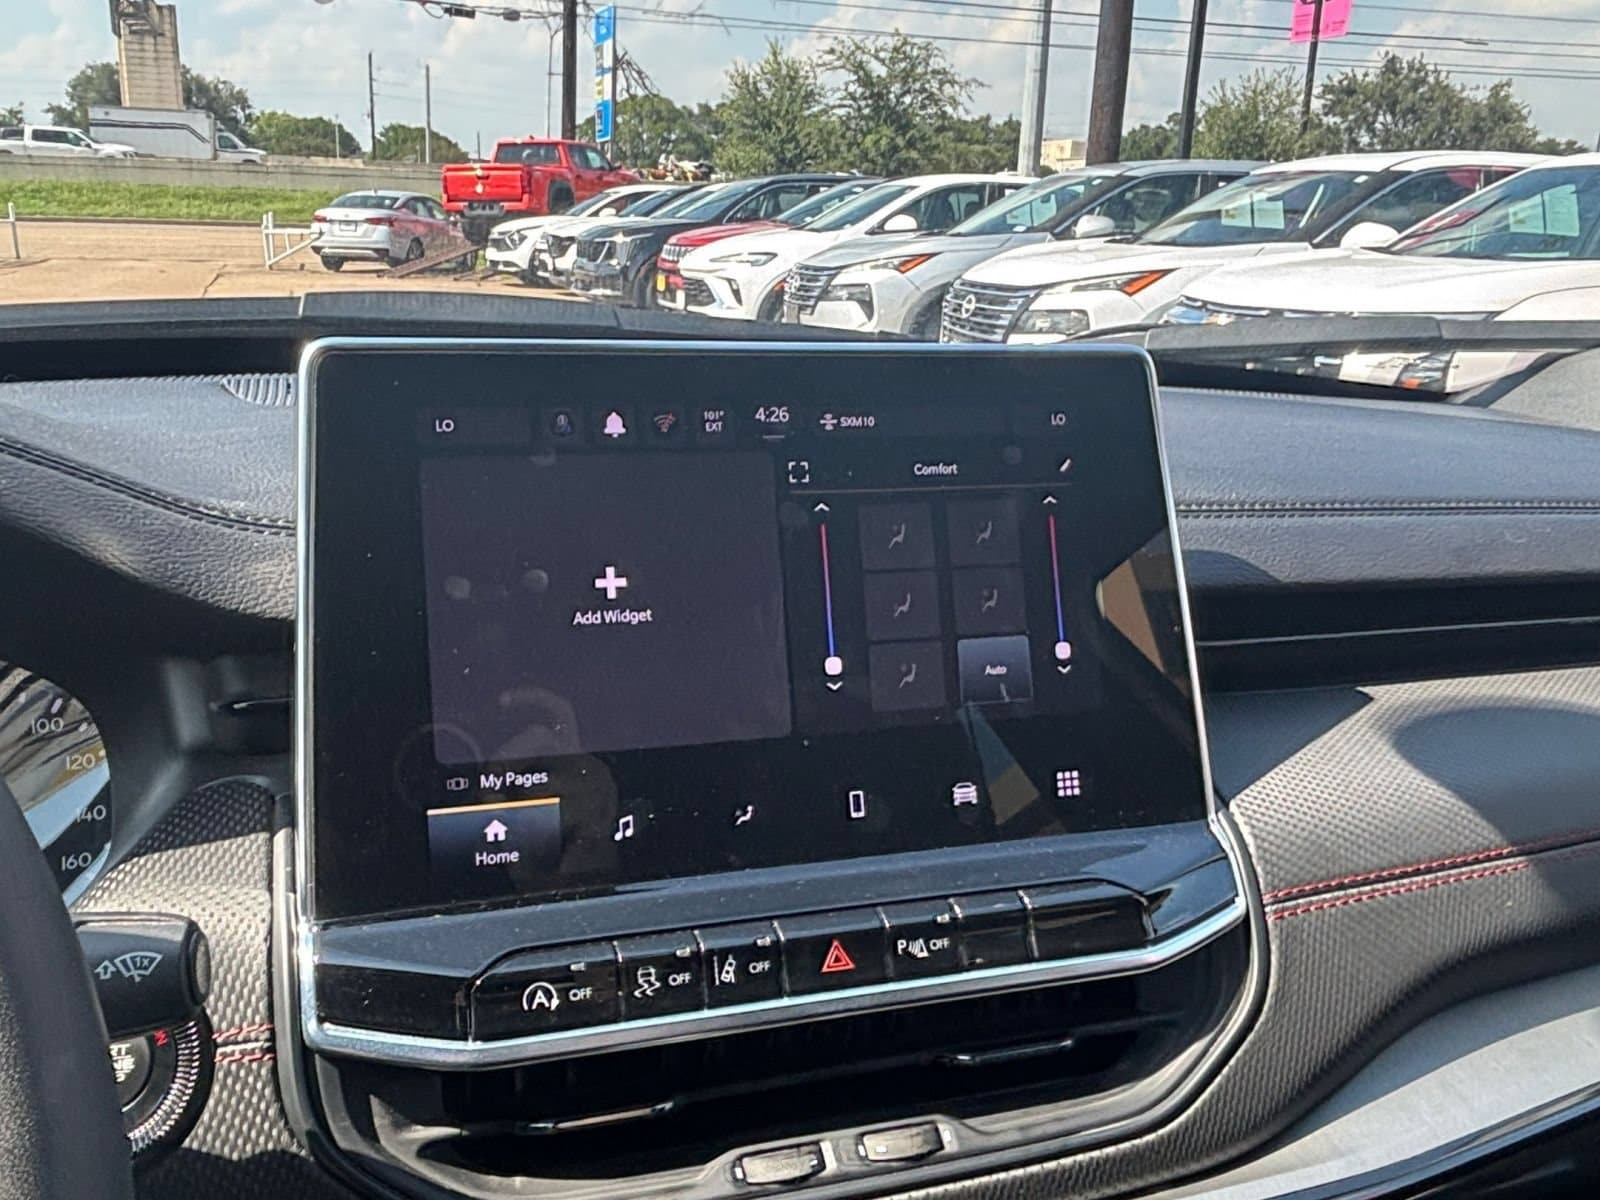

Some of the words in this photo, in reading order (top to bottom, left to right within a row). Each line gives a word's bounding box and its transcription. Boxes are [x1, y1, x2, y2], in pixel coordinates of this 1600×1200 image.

[754, 406, 790, 422] 4:26
[1050, 413, 1066, 426] LO
[435, 419, 455, 433] LO
[705, 421, 723, 432] EXT
[913, 463, 959, 475] Comfort
[572, 611, 601, 625] Add
[603, 608, 652, 625] Widget
[984, 664, 1007, 676] Auto
[31, 717, 64, 734] 100
[65, 755, 96, 770] 120
[479, 774, 503, 791] My
[505, 771, 549, 789] Pages
[76, 804, 106, 822] 140
[61, 852, 92, 871] 160
[475, 850, 520, 866] Home
[929, 937, 950, 951] OFF
[749, 960, 771, 974] OFF
[668, 973, 692, 987] OFF
[569, 987, 593, 1001] OFF
